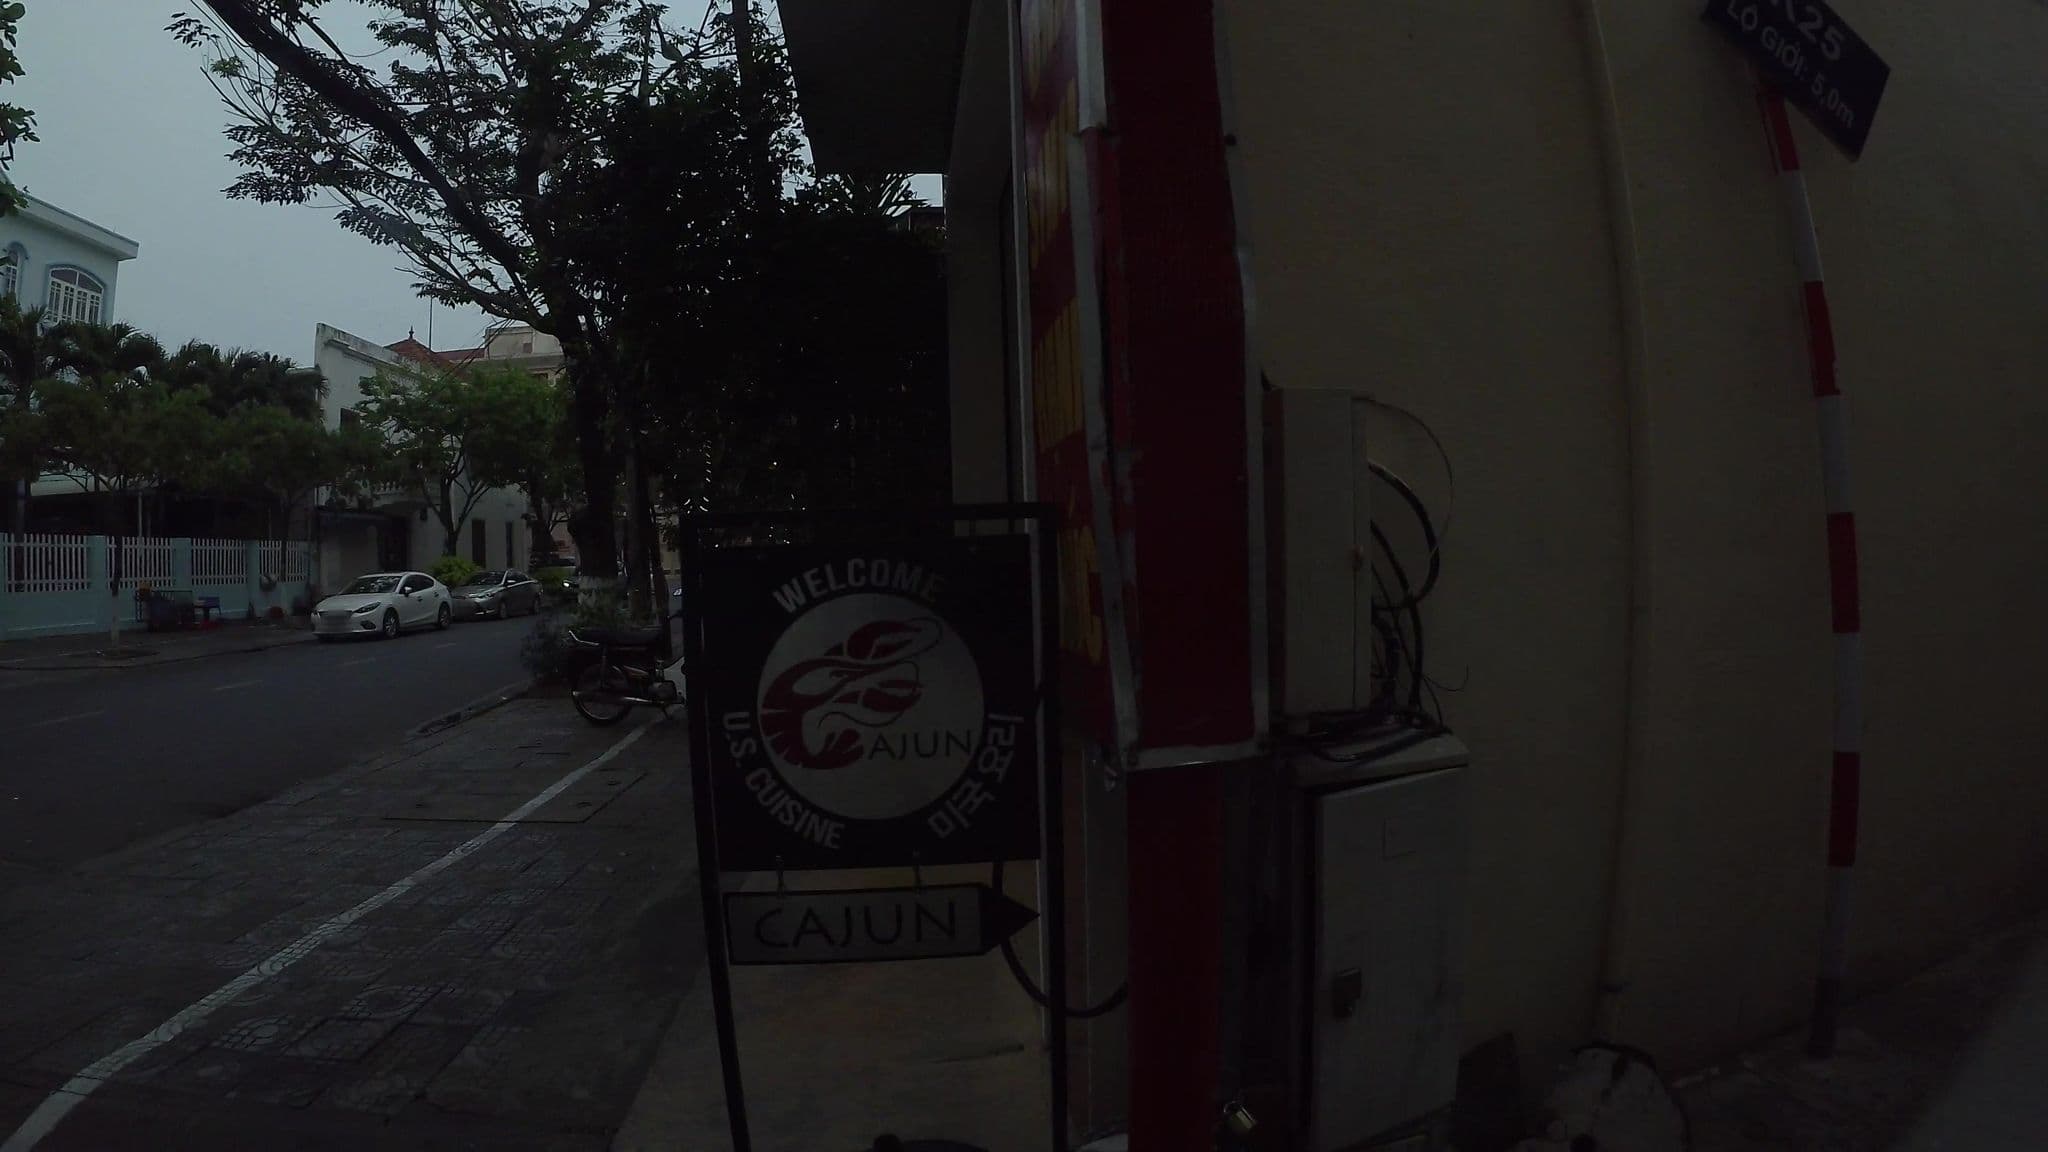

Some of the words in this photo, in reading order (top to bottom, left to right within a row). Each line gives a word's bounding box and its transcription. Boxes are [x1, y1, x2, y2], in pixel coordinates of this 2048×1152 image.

[771, 557, 948, 614] WELCOME
[744, 766, 846, 850] CUISINE
[926, 779, 997, 840] 미국
[976, 711, 1025, 785] 요리
[754, 900, 958, 949] CAJUN
